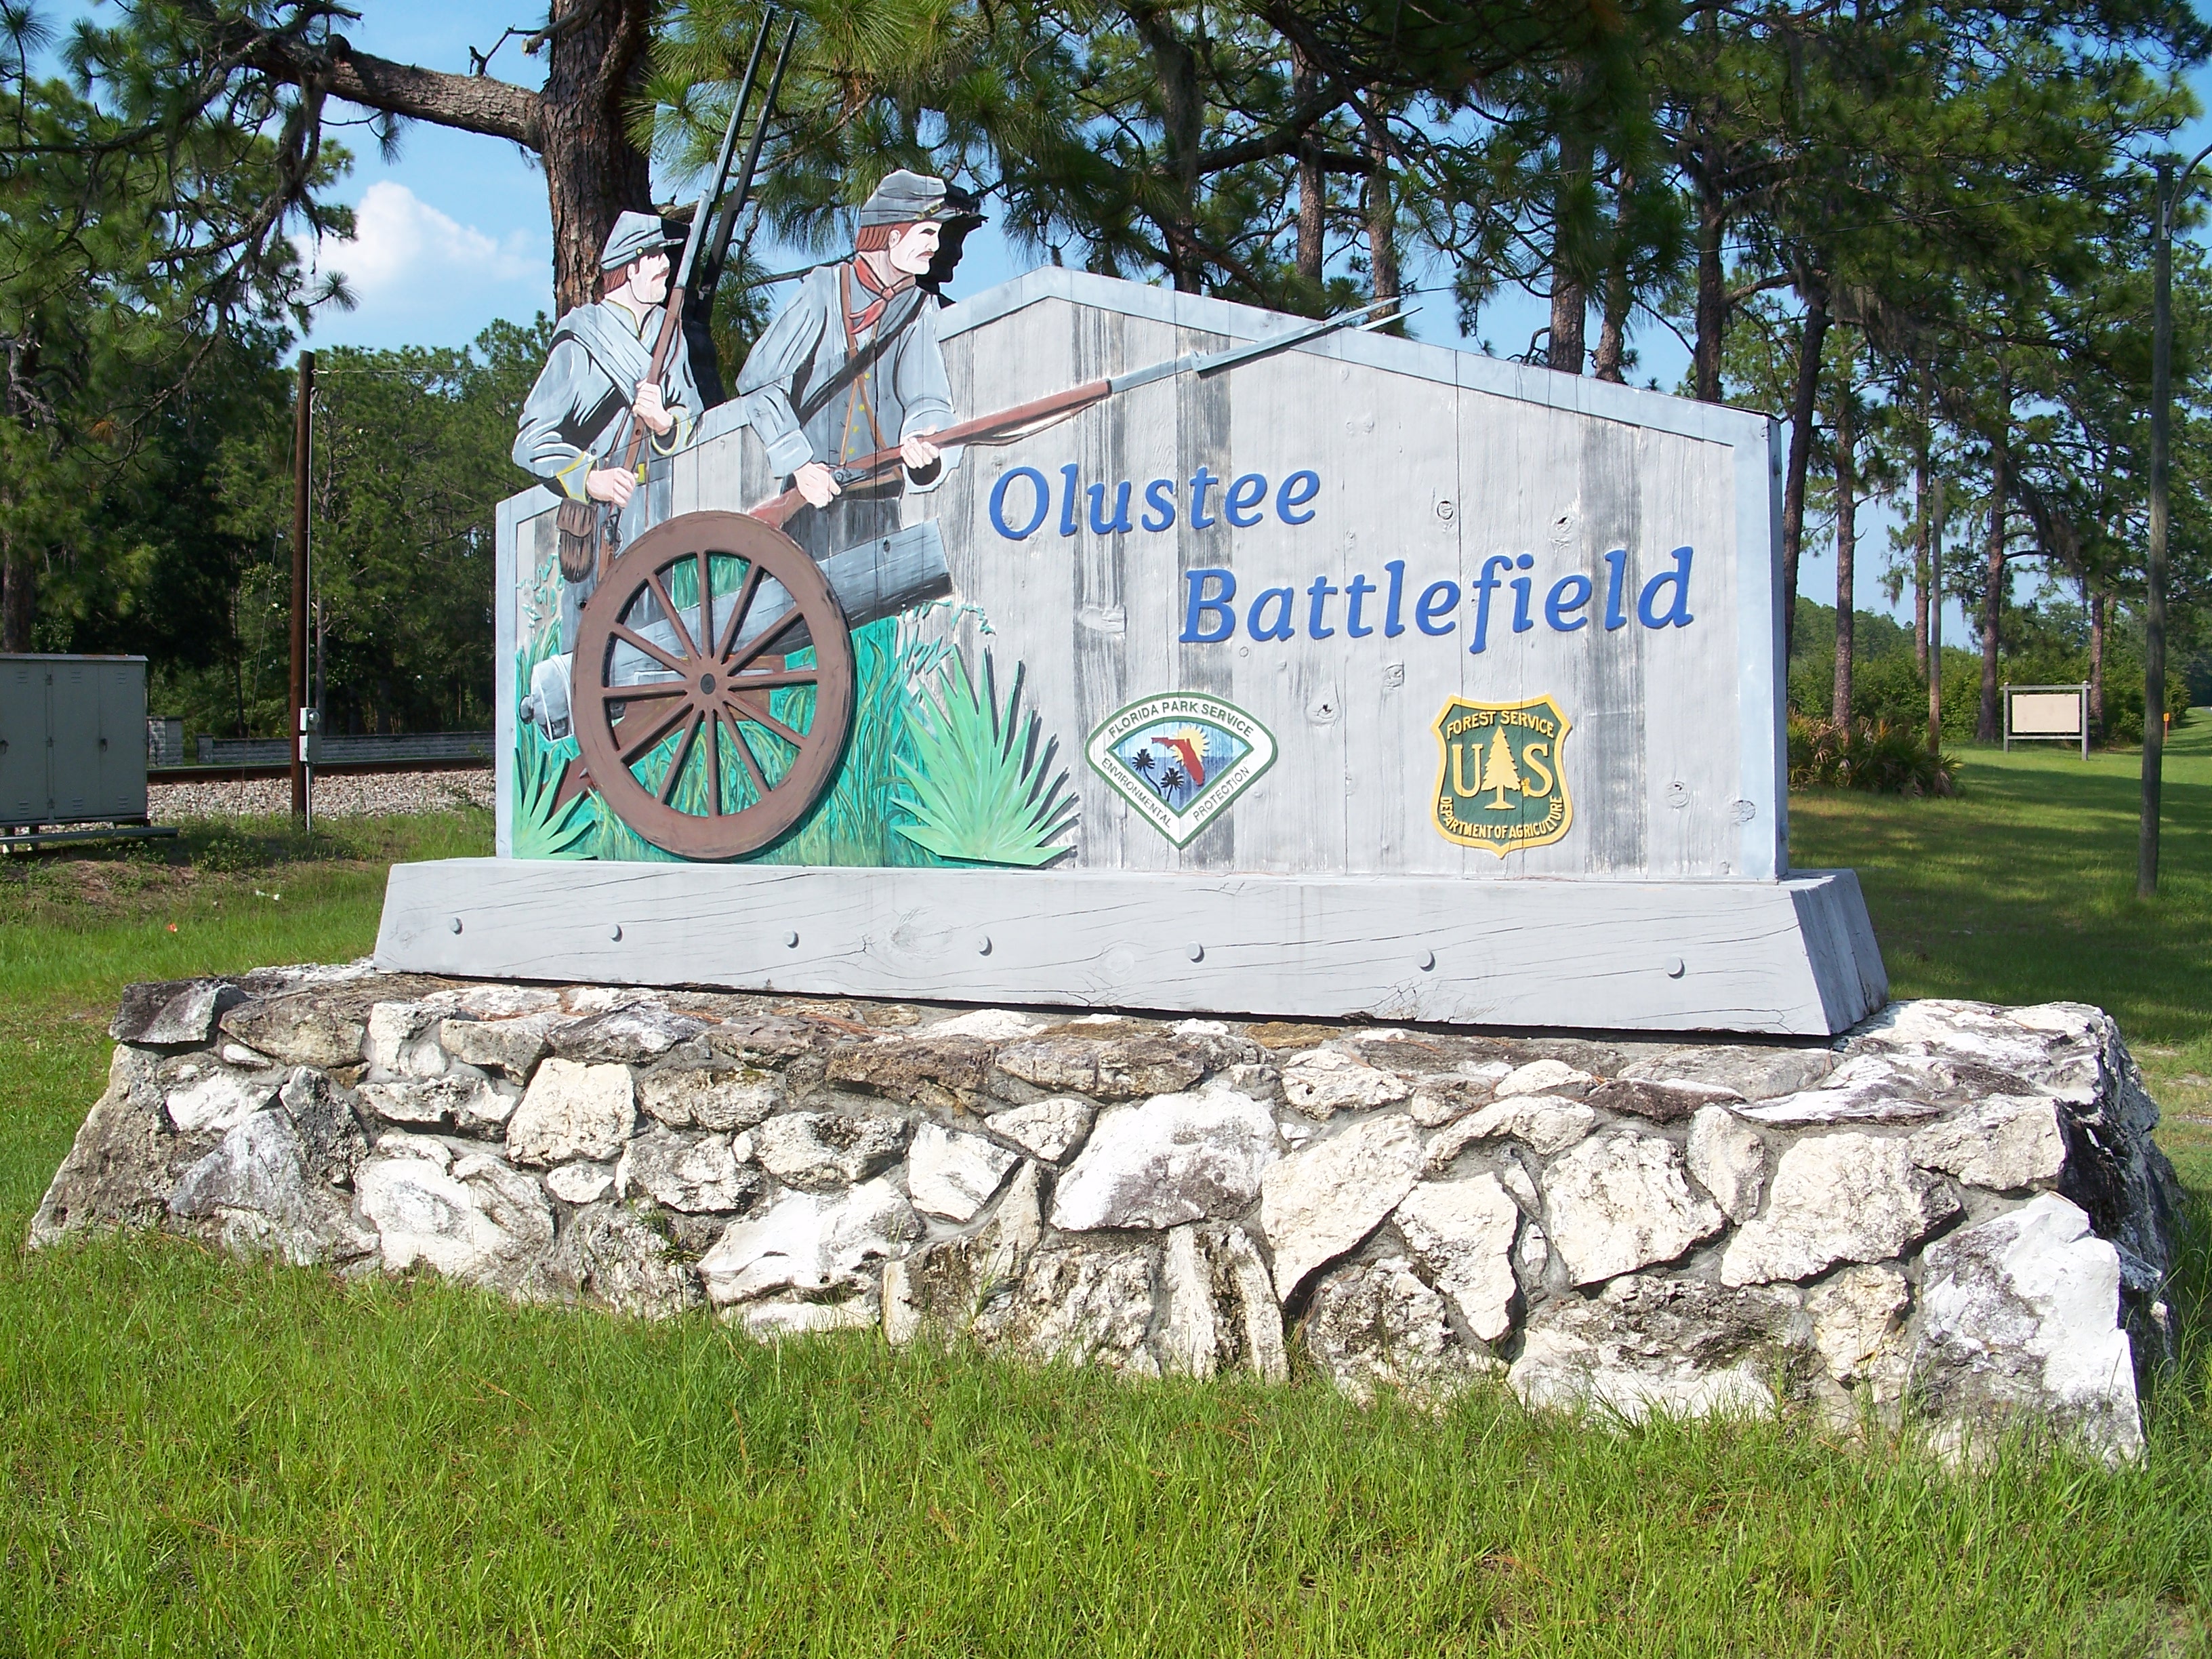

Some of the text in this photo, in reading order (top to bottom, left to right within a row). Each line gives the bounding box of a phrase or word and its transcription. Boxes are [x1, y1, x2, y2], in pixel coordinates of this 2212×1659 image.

[989, 463, 1320, 541] Olustee
[1179, 546, 1694, 654] Battlefield
[1108, 701, 1254, 739] FLORIDA PARK SERVICE
[1446, 710, 1554, 739] FOREST SERVICE
[1101, 757, 1172, 828] ENVIRONMENTAL
[1193, 766, 1250, 821] PROTECTION
[1440, 796, 1563, 839] DEPARTMENT OF AGRICULTURE
